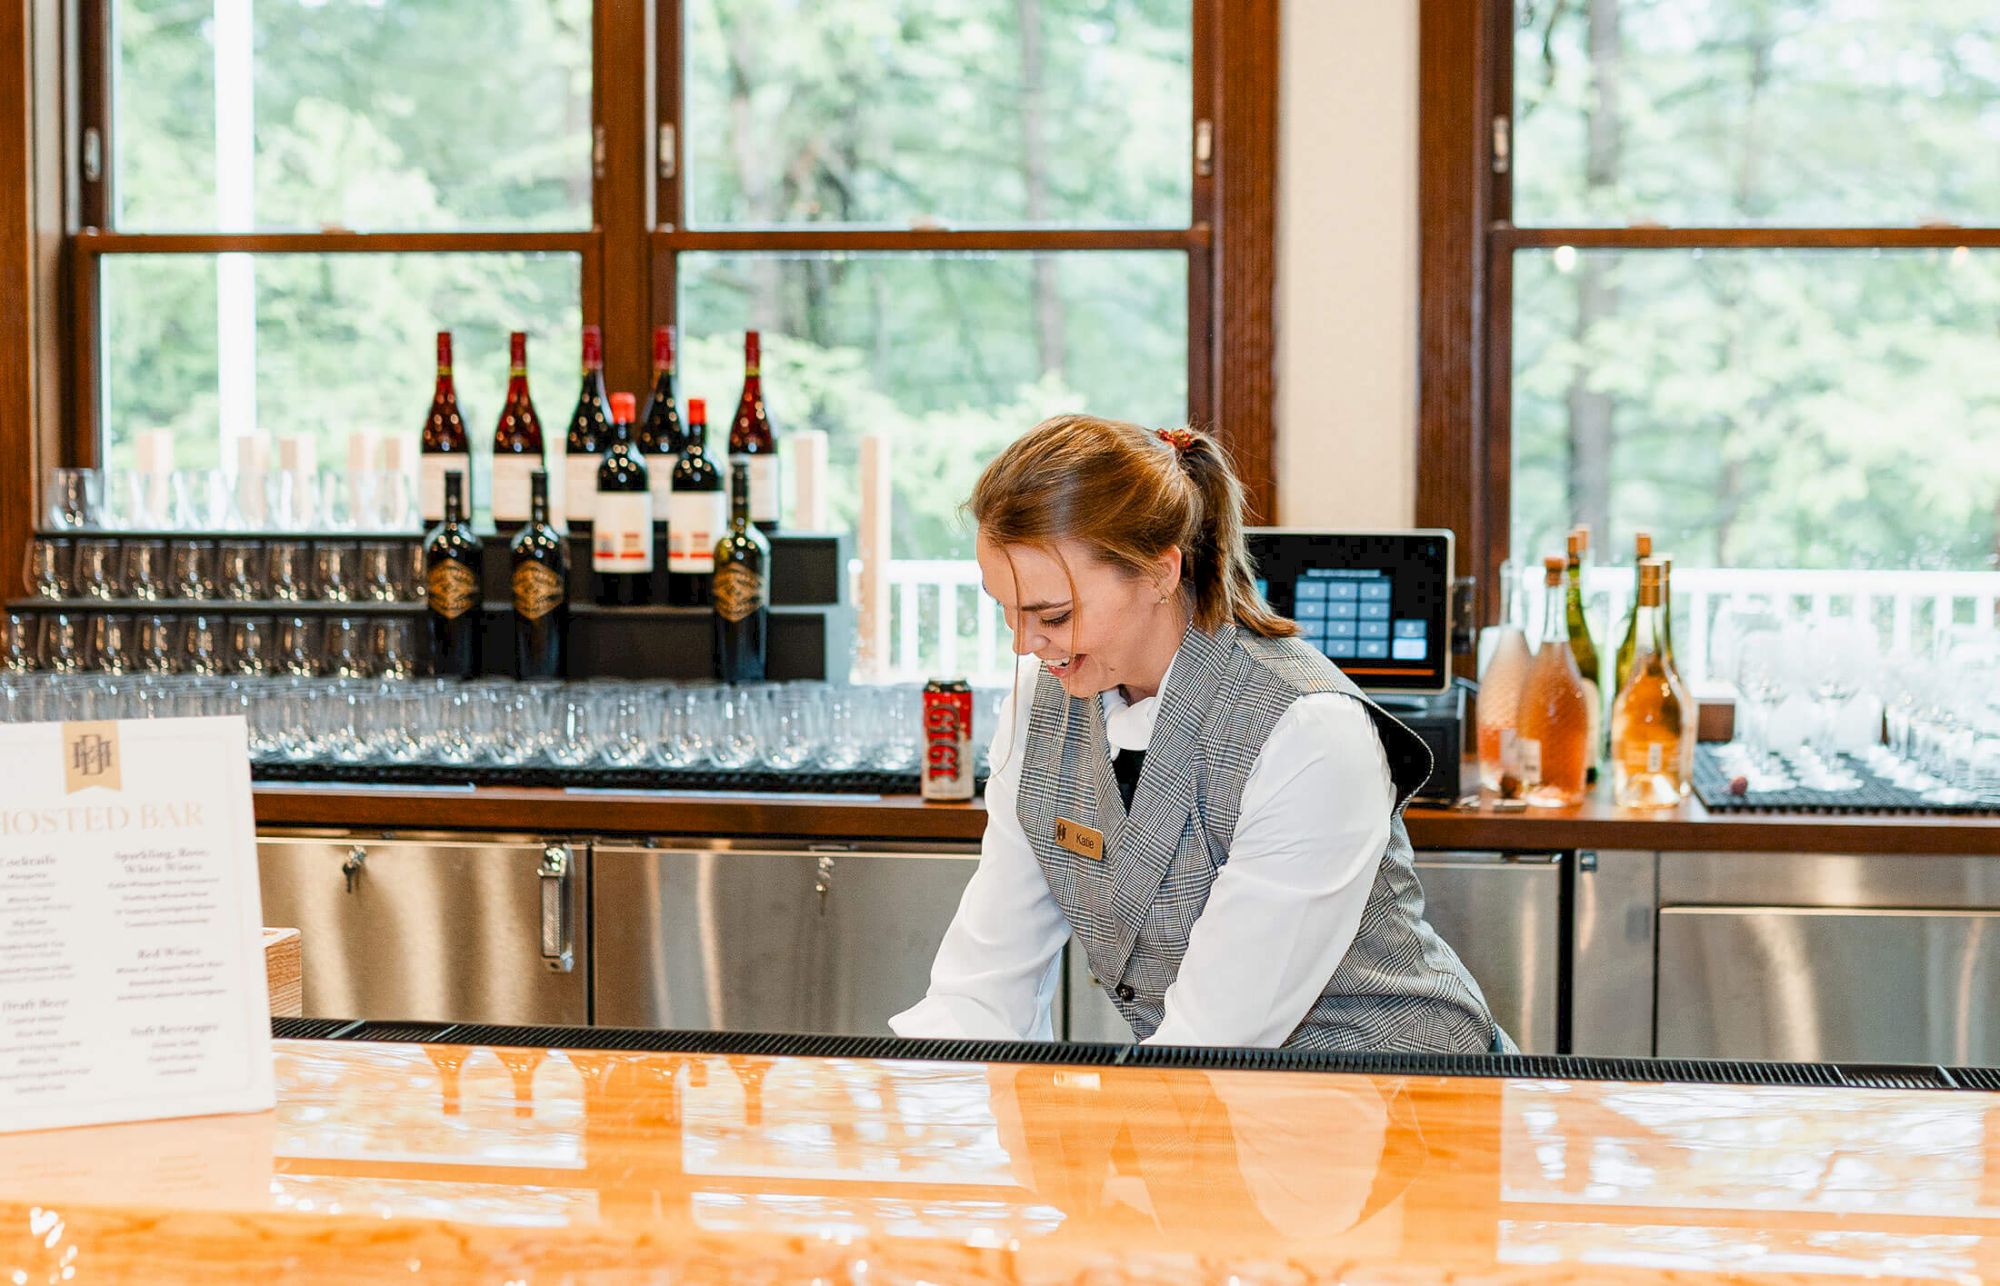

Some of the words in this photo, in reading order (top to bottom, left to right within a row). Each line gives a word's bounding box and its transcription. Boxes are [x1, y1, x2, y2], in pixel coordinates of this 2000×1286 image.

[140, 799, 205, 830] BAR
[1076, 832, 1095, 849] Katie
[137, 948, 160, 959] Red
